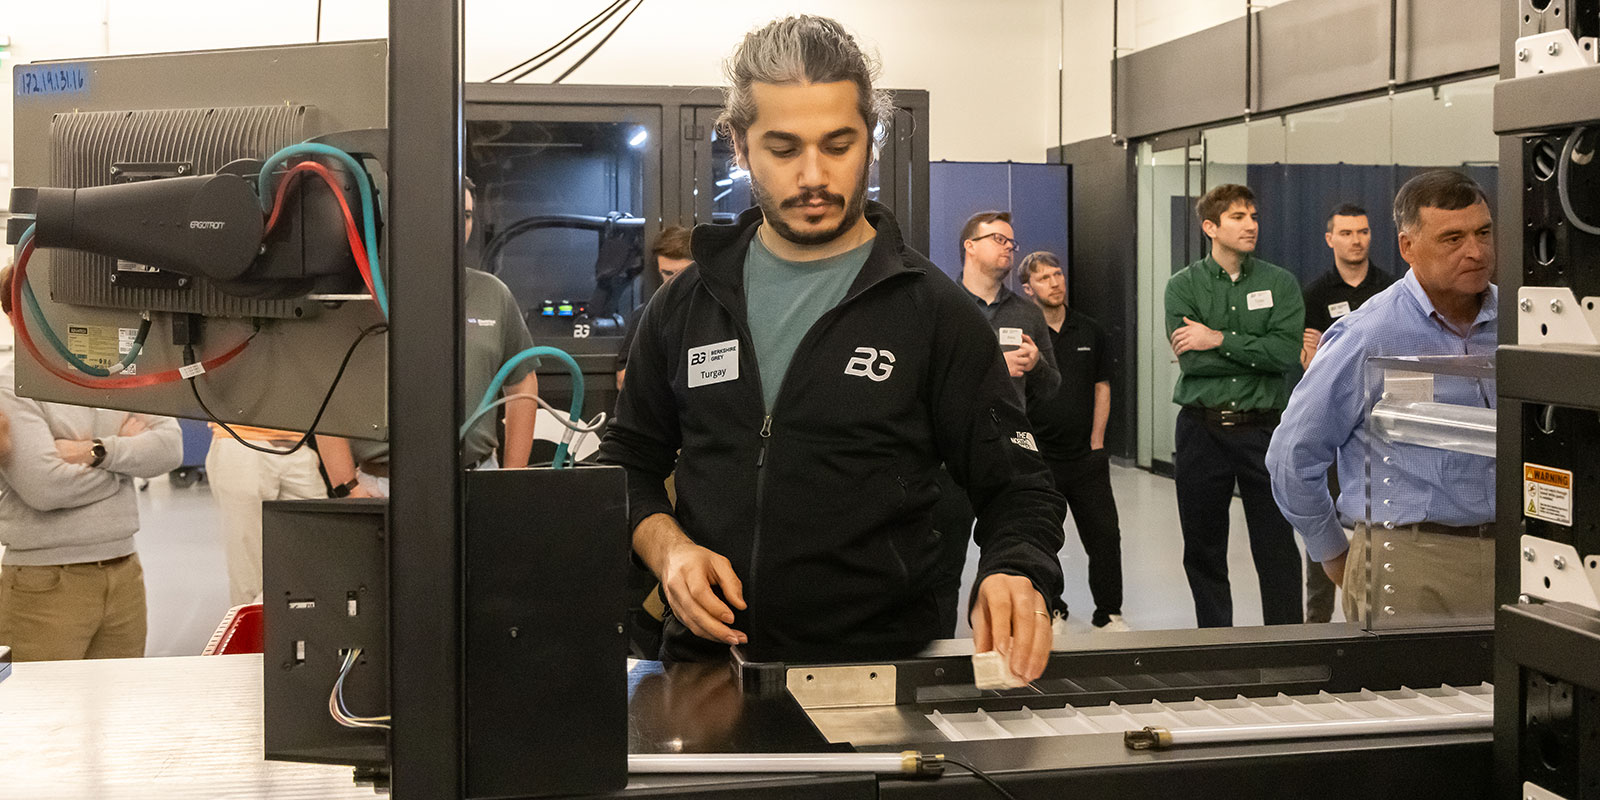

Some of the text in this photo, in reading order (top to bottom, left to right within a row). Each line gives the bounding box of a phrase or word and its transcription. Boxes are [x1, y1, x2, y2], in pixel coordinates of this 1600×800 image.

[573, 324, 590, 338] BG
[691, 352, 706, 365] BG
[844, 346, 896, 382] BG
[700, 368, 727, 379] Turgay
[1534, 470, 1569, 486] WARNING
